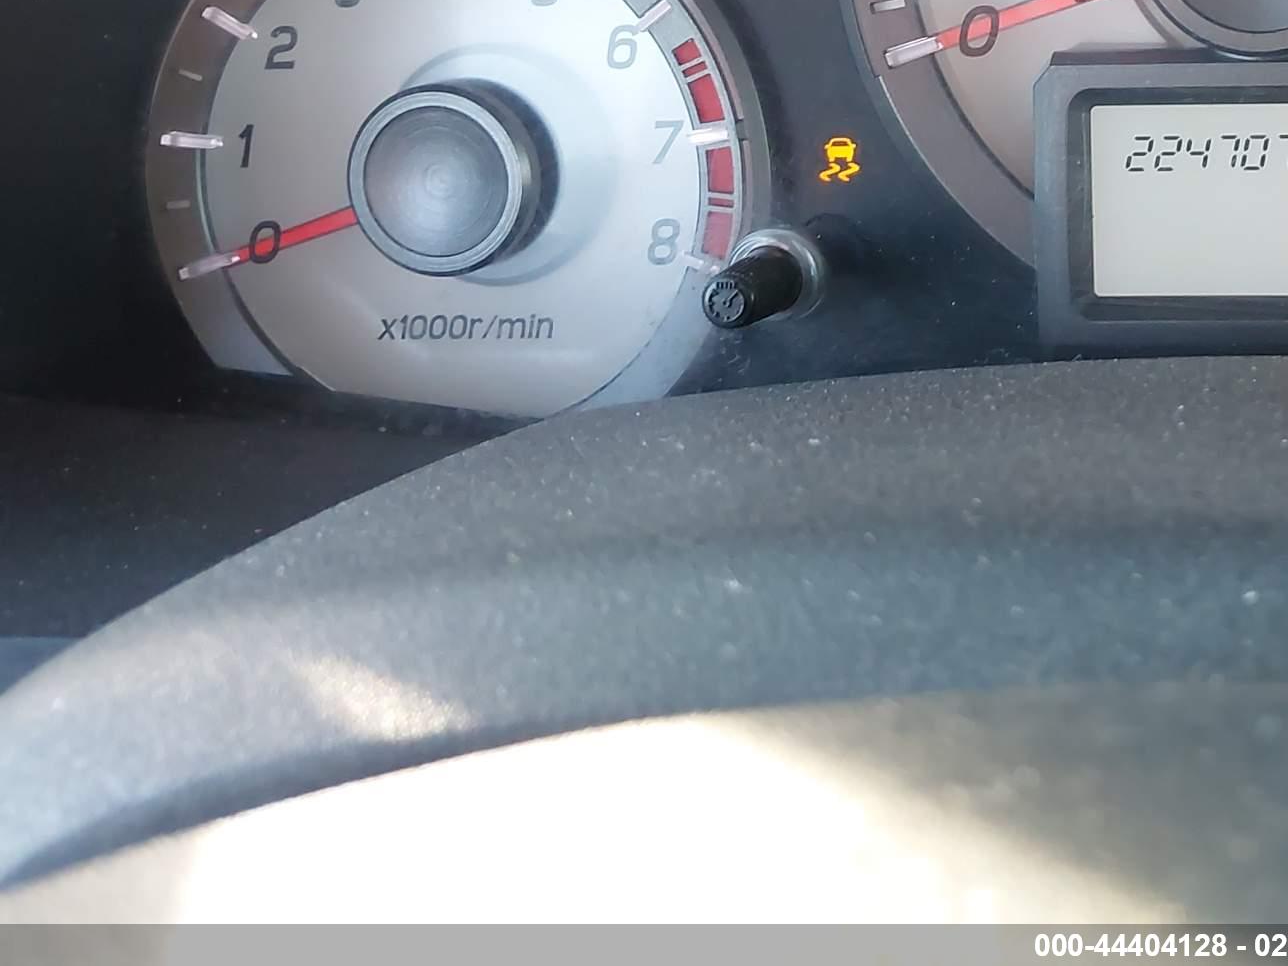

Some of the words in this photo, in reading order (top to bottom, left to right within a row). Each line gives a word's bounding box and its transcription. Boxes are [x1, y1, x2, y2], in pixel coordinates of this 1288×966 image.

[264, 25, 299, 70] 2
[605, 24, 638, 70] 6
[958, 6, 1001, 58] 0
[238, 124, 254, 168] 1
[653, 120, 684, 165] 7
[249, 220, 282, 264] 0
[646, 217, 681, 265] 8
[377, 314, 554, 342] x1000r/min
